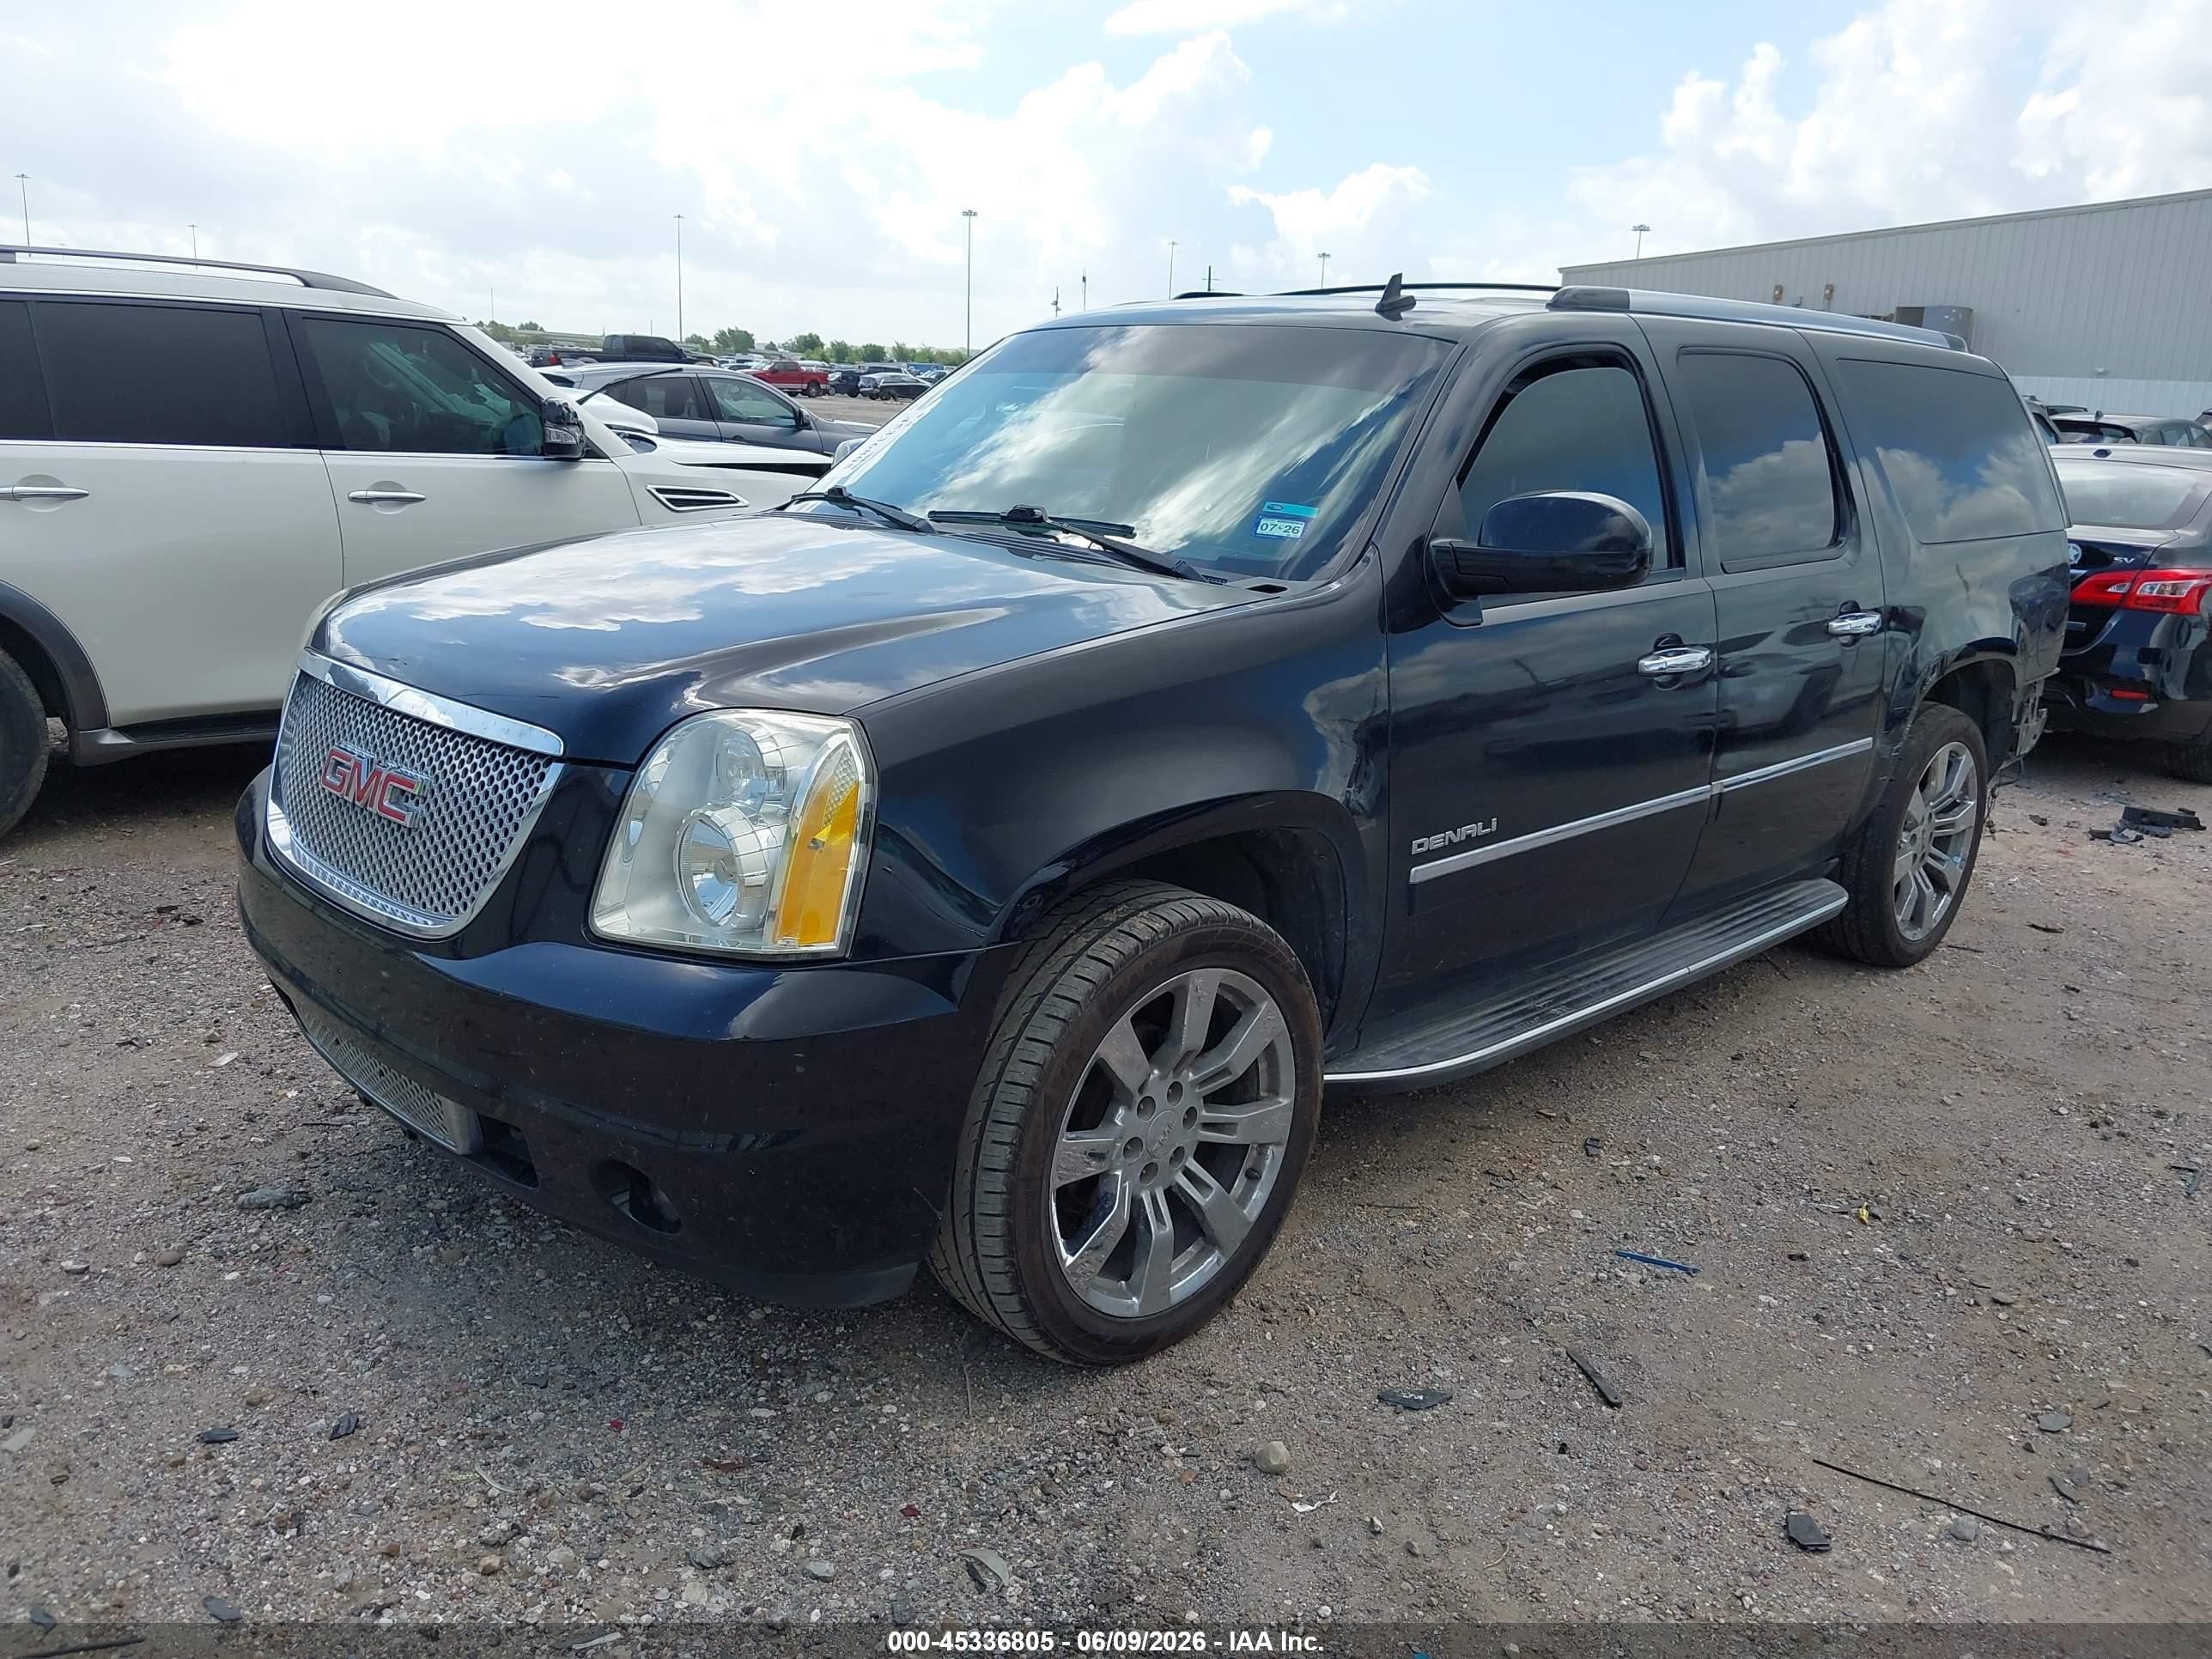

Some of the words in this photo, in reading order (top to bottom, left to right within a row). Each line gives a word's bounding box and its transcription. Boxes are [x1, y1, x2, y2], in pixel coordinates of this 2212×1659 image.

[2113, 555, 2136, 564] SV
[321, 745, 427, 828] GMC
[1411, 817, 1498, 855] DENALI
